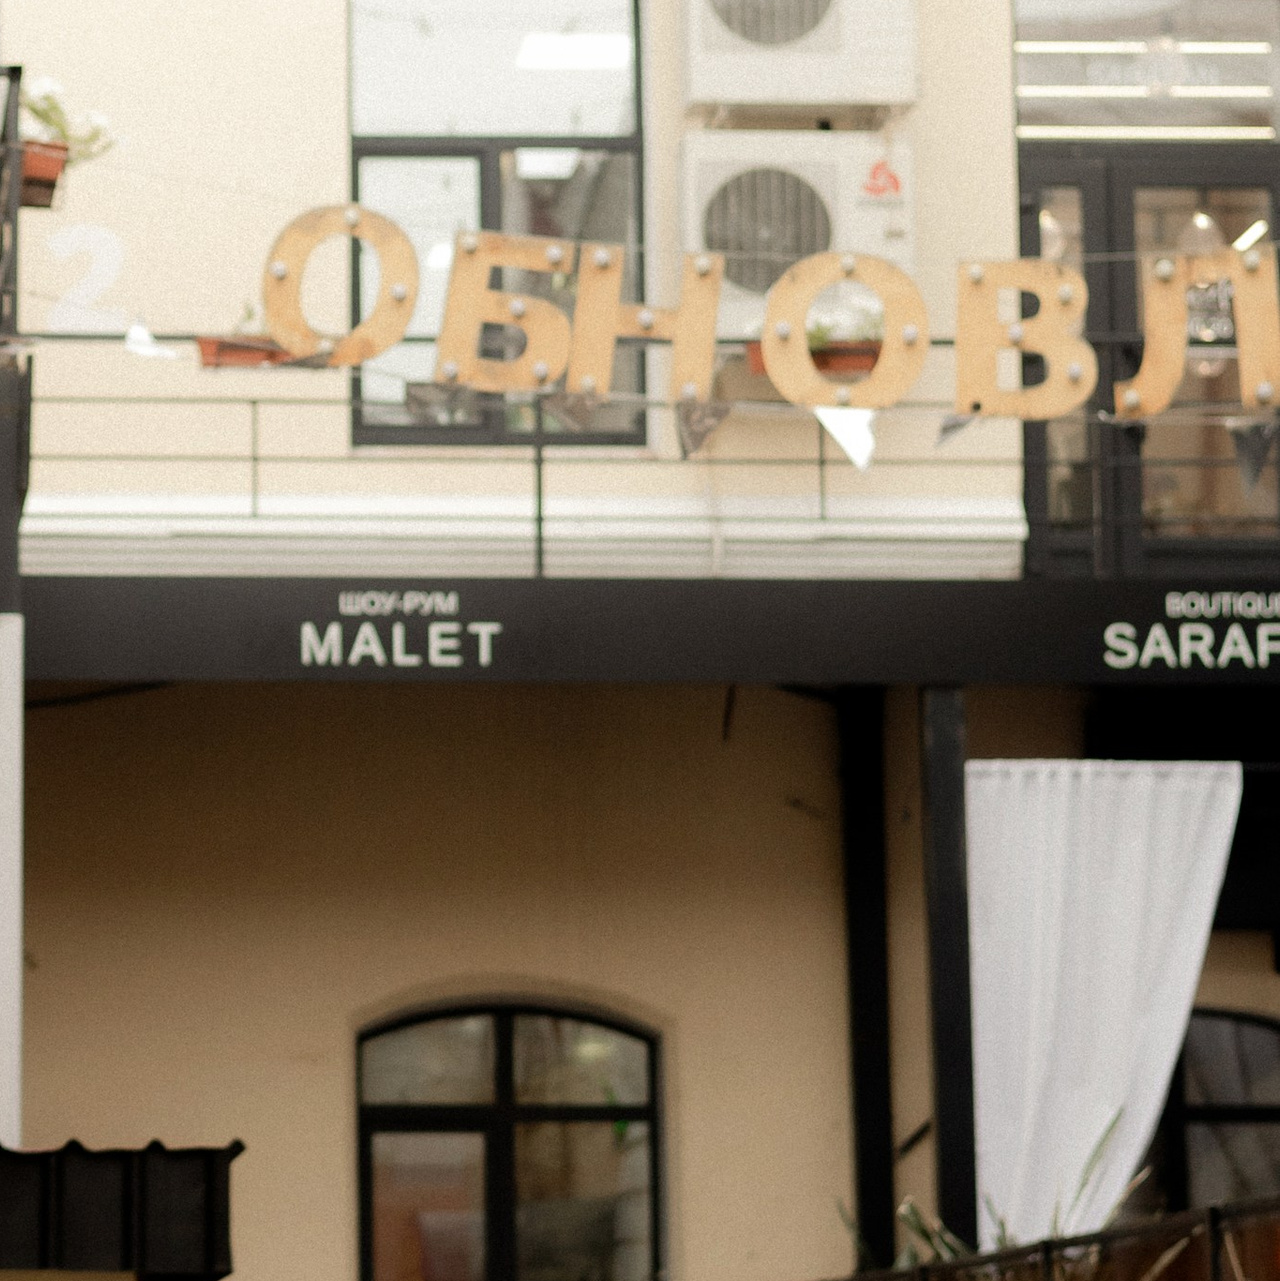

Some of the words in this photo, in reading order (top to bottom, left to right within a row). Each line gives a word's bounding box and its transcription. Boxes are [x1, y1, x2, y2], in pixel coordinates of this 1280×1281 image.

[46, 223, 129, 333] 2
[261, 202, 1280, 421] ОБНОВЛ
[337, 589, 460, 616] ШОУ-РУМ
[299, 620, 504, 668] MALET
